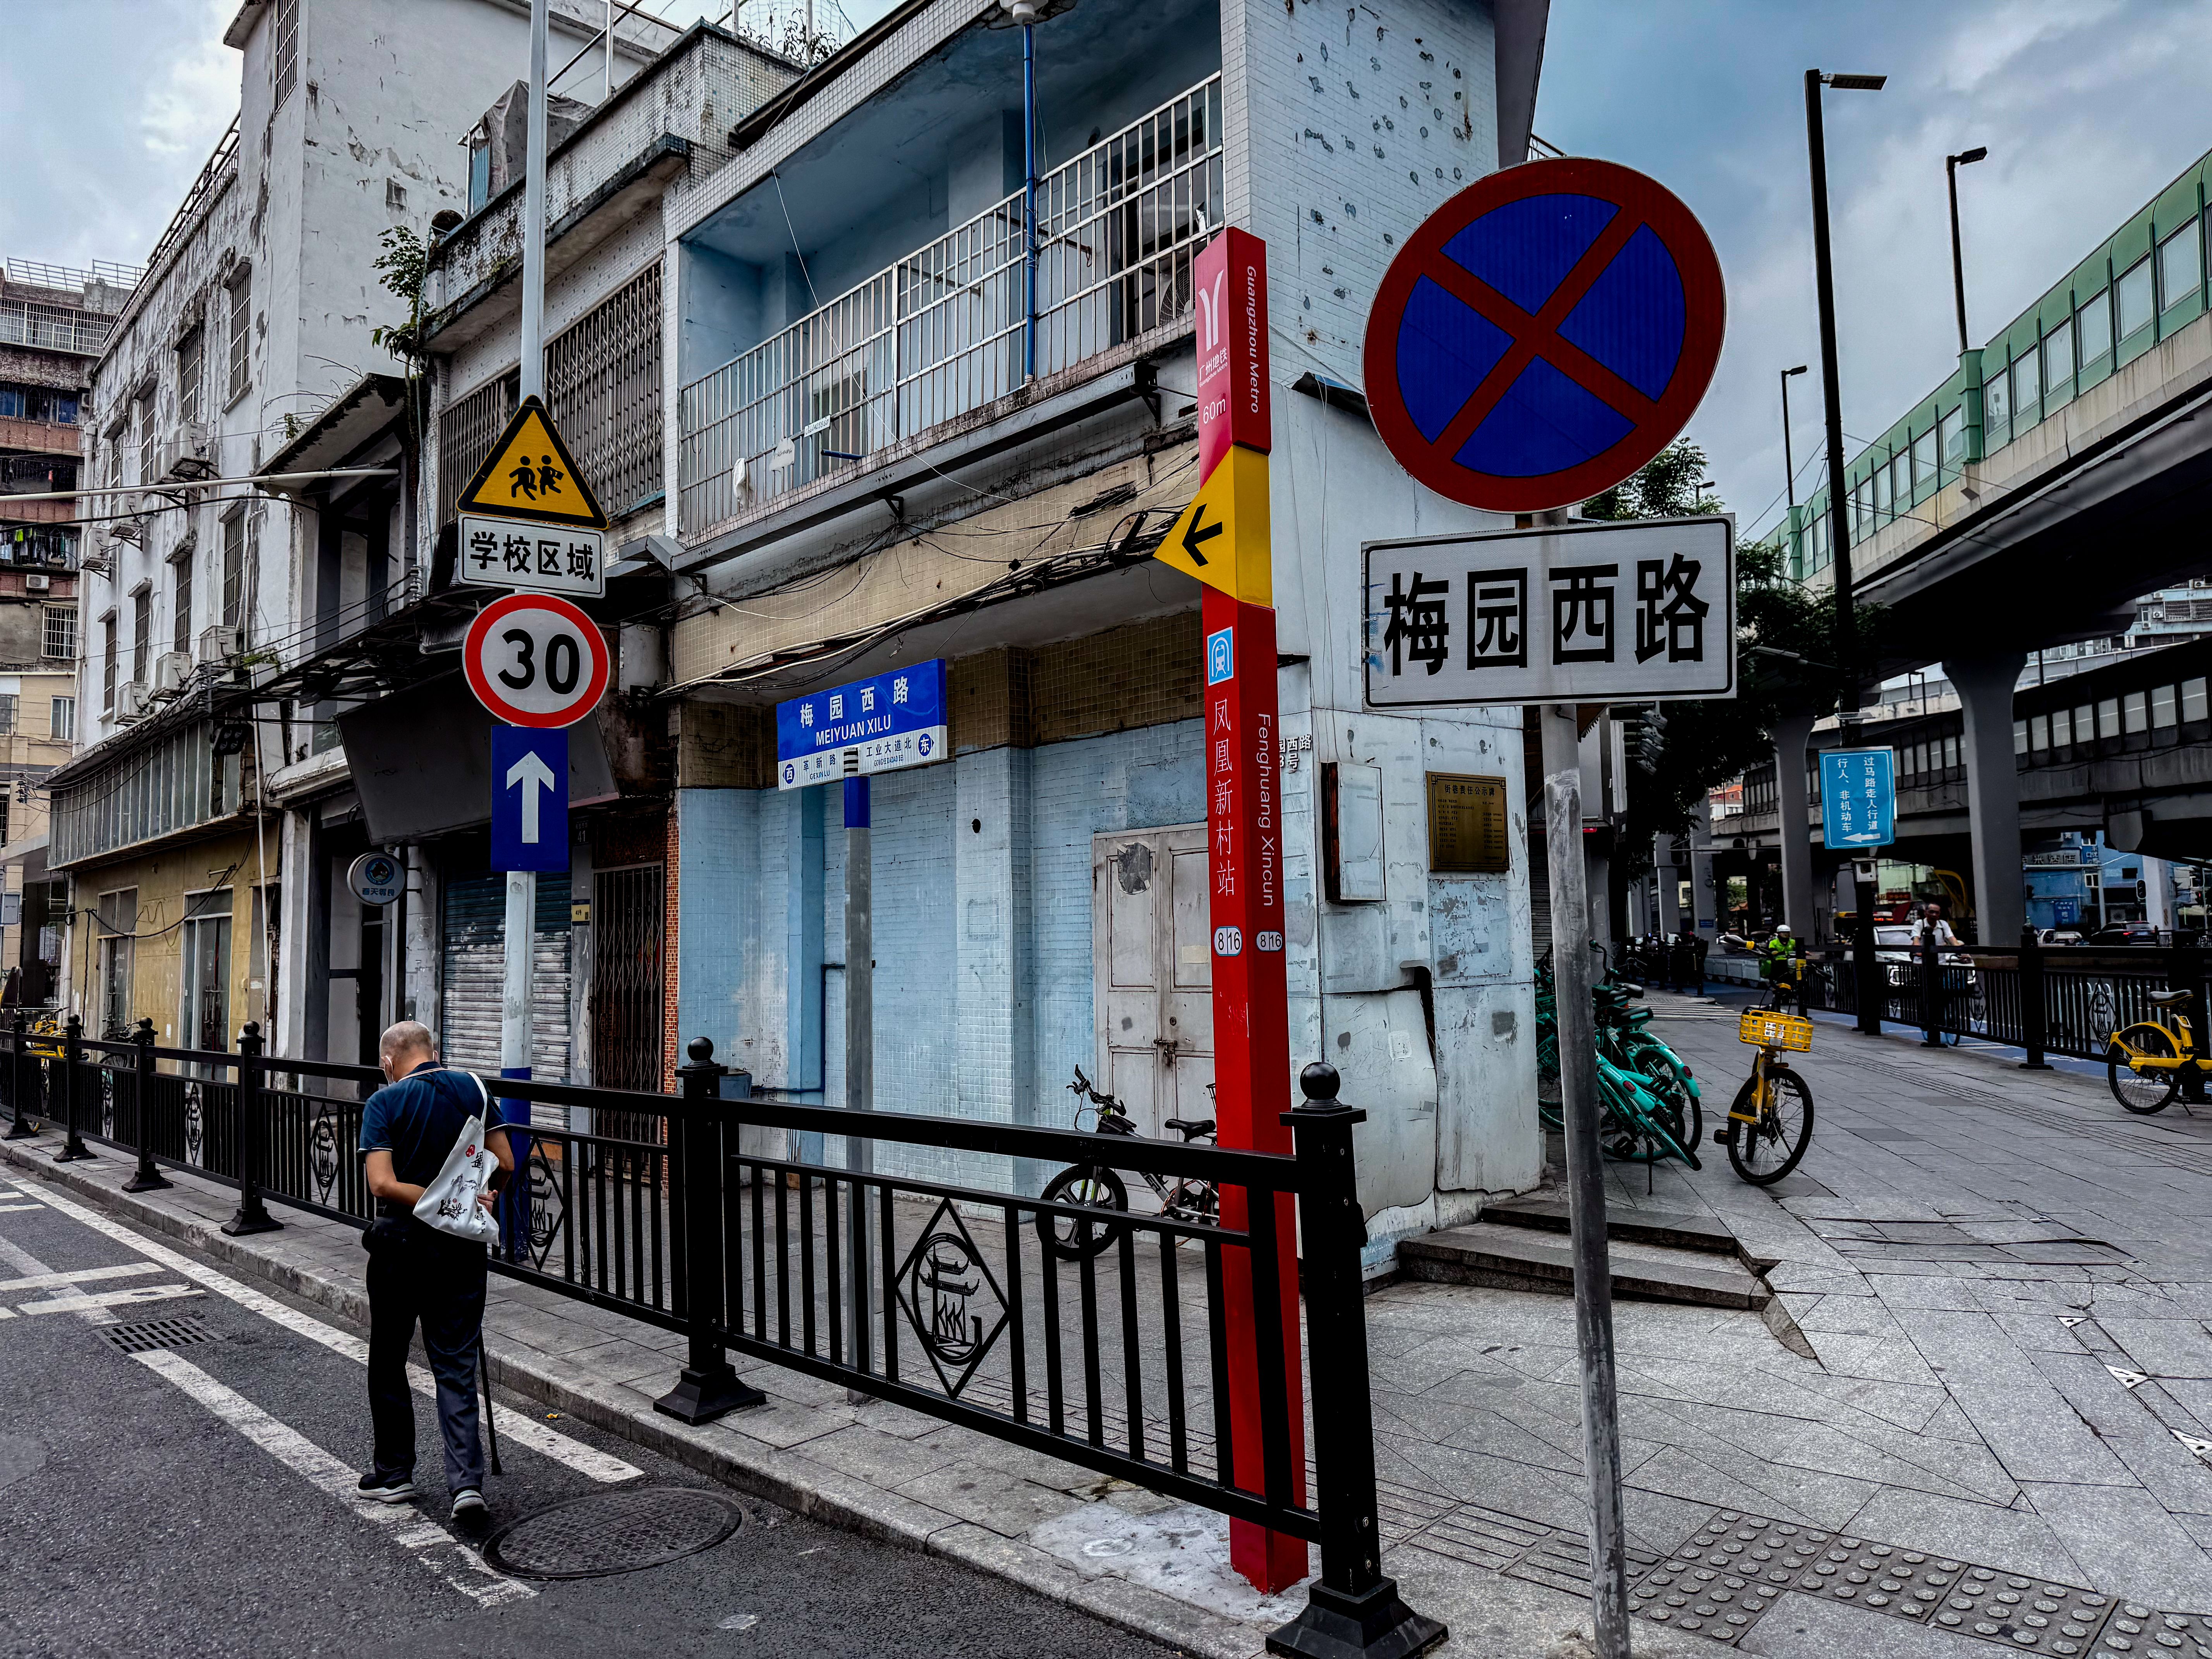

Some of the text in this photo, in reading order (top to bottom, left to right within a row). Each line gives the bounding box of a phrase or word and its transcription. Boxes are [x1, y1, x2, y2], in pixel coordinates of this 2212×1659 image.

[1199, 347, 1227, 381] 广州地铁
[1247, 265, 1259, 413] Guangzhou Metro
[1203, 398, 1226, 424] 60m
[469, 531, 595, 582] 学校区域
[1384, 552, 1710, 677] 梅园西路
[497, 628, 580, 696] 30
[800, 676, 908, 728] 梅园西路
[816, 714, 891, 746] MEIYUAN XILU
[866, 737, 912, 757] 工业大道北
[920, 737, 929, 753] 东
[786, 767, 793, 781] 西
[803, 754, 836, 771] 革新路
[1213, 698, 1235, 896] 凤凰新村站
[1255, 713, 1274, 906] Fenghuang Xincun
[1444, 784, 1495, 797] 街巷责任公示牌
[1837, 758, 1852, 832] 行人、非机动车
[1863, 756, 1878, 830] 过马路走人行道
